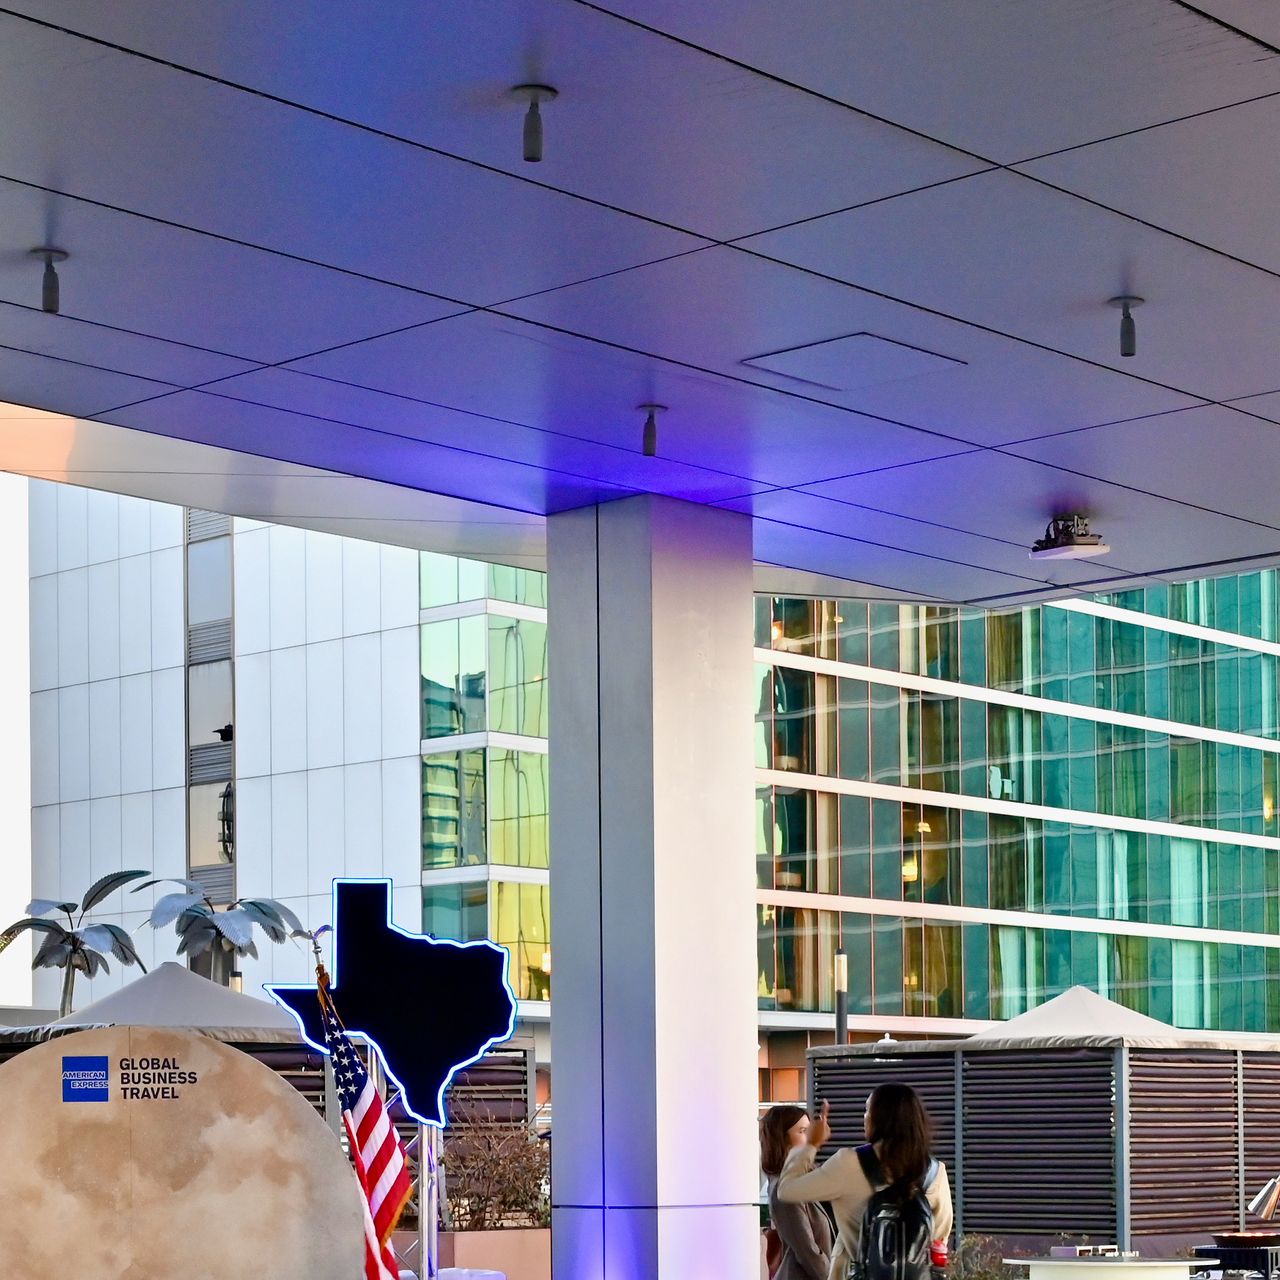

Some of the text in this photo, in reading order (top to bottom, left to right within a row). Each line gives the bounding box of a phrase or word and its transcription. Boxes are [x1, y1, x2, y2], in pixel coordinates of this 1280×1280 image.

[119, 1058, 179, 1070] GLOBAL
[62, 1071, 105, 1079] AMERICAN
[120, 1072, 197, 1084] BUSINESS
[121, 1087, 179, 1099] TRAVEL
